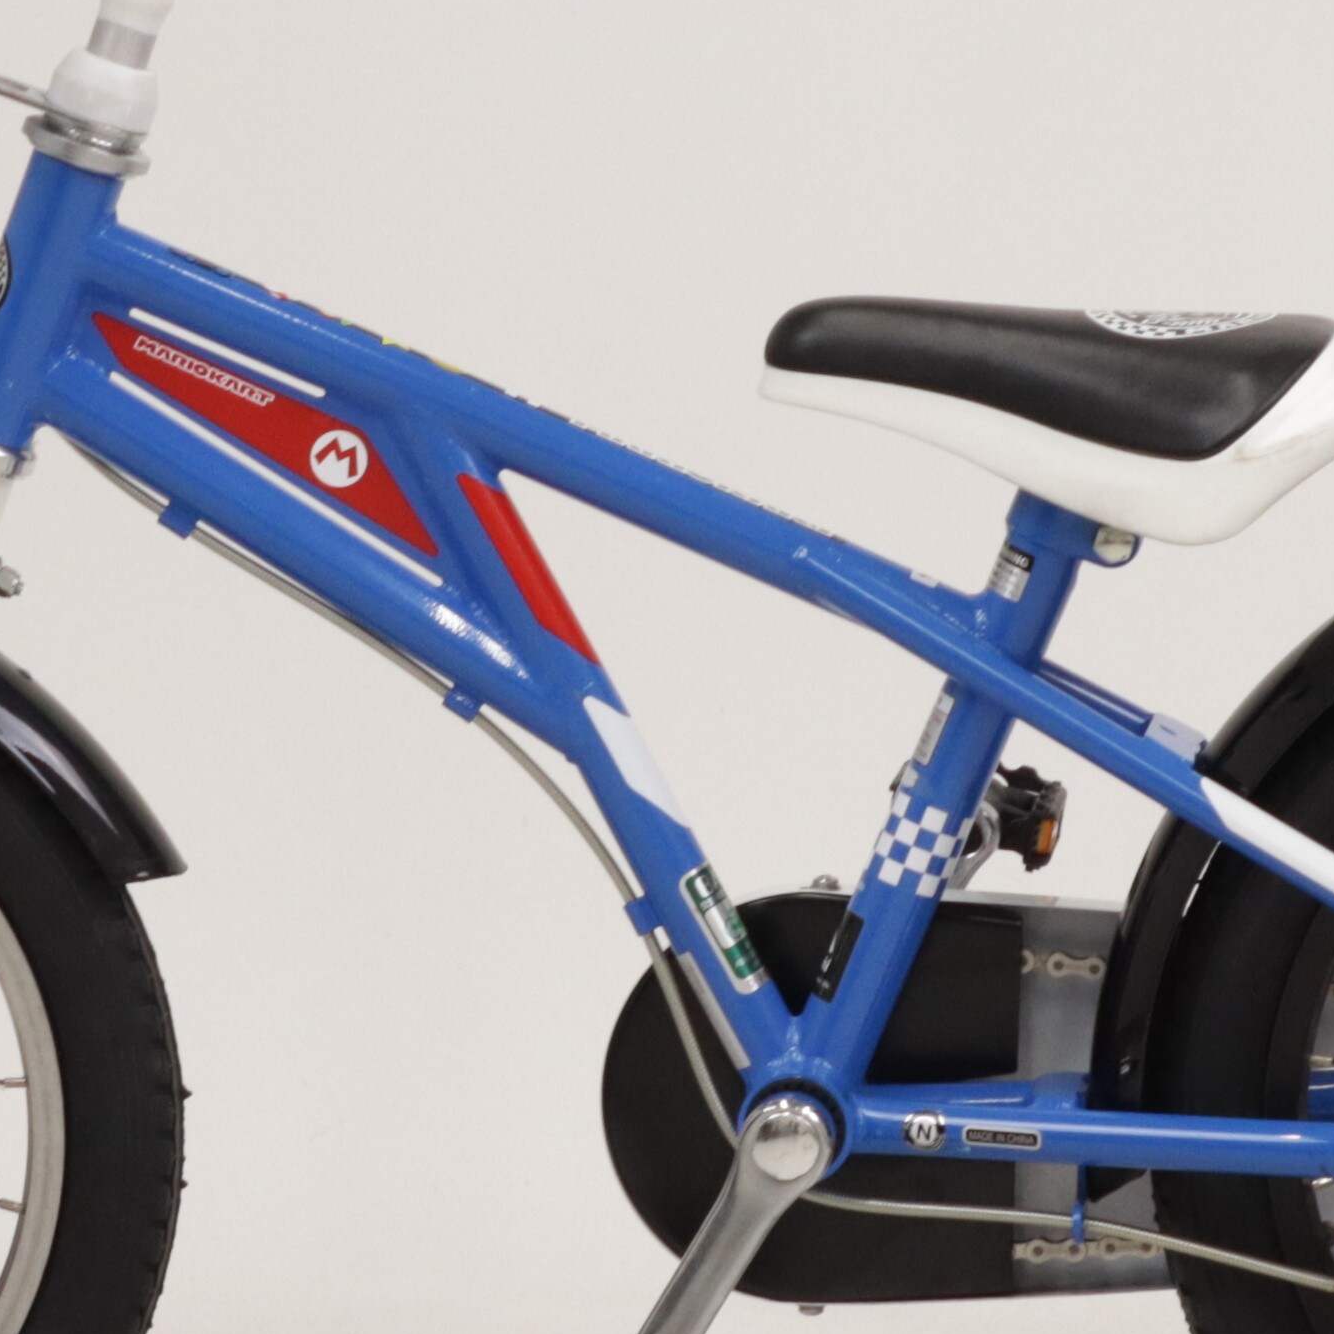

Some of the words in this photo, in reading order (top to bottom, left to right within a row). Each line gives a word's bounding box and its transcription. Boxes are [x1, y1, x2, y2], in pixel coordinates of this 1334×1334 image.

[133, 335, 275, 406] MARIOKART
[314, 437, 359, 479] M
[917, 1123, 931, 1141] N
[968, 1131, 993, 1143] MADE
[996, 1133, 1005, 1143] IN
[1007, 1134, 1035, 1145] CHINA
